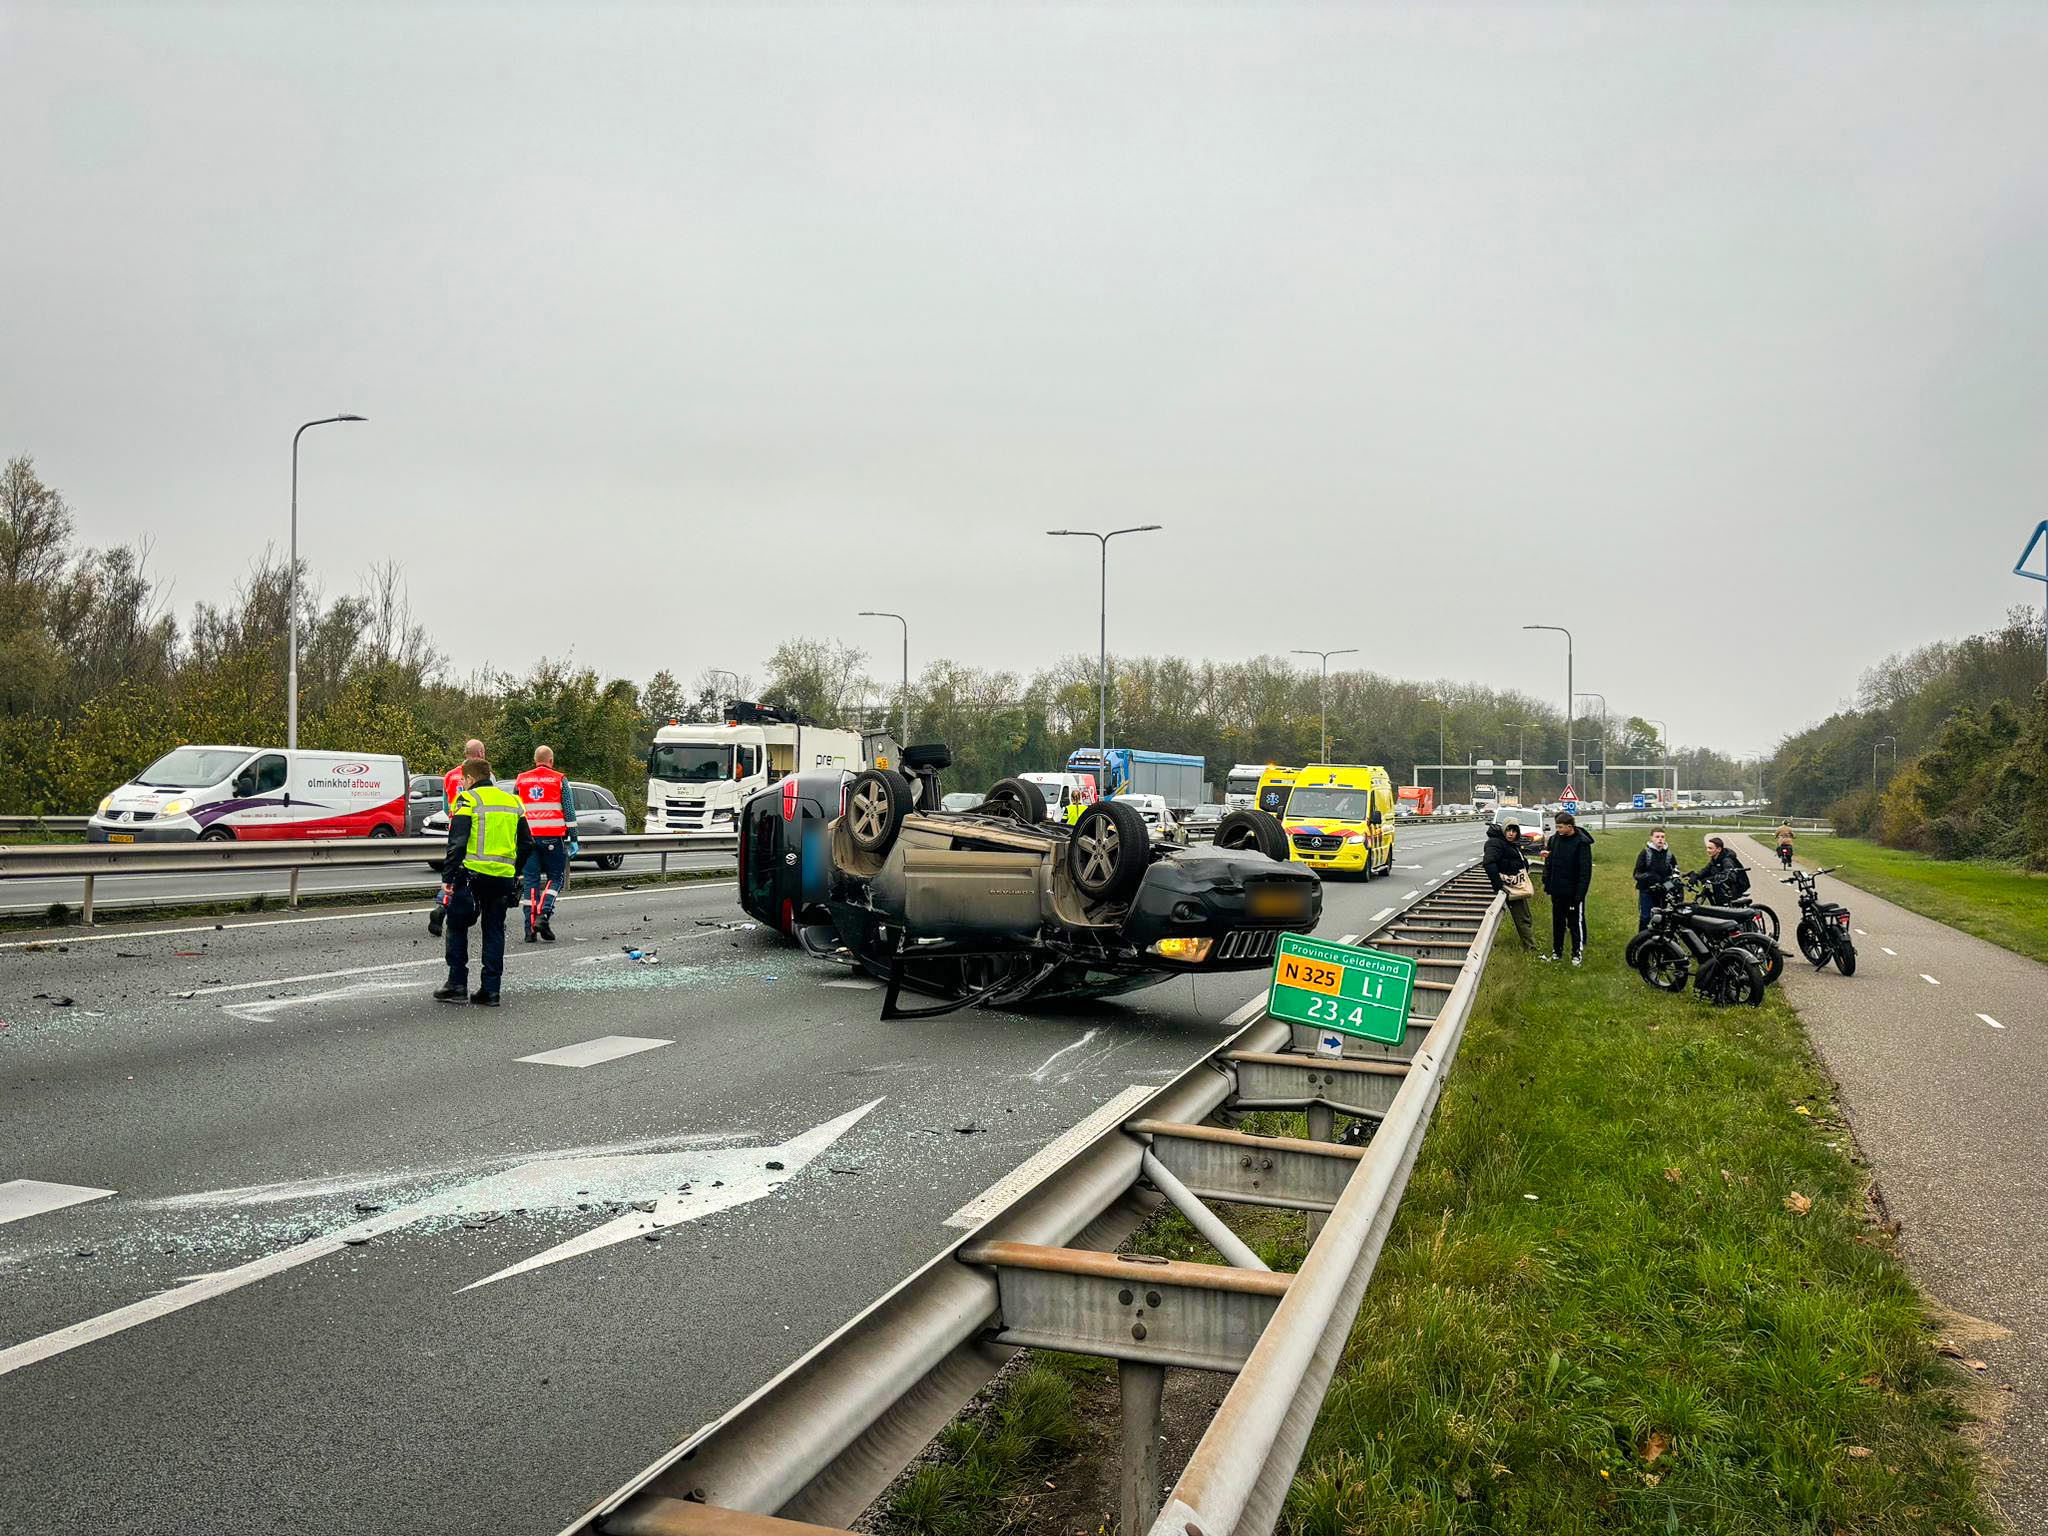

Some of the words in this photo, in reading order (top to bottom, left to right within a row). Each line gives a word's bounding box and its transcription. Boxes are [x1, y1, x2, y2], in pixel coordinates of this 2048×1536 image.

[815, 754, 833, 768] pre
[307, 778, 351, 788] olminkhof
[351, 778, 381, 789] afbouw
[1563, 802, 1575, 810] 50
[1292, 944, 1339, 962] Provincie
[1342, 954, 1400, 974] Gelderland
[1285, 963, 1299, 979] N
[1302, 967, 1336, 987] 325
[1361, 976, 1383, 999] Li
[1307, 997, 1363, 1027] 23,4
